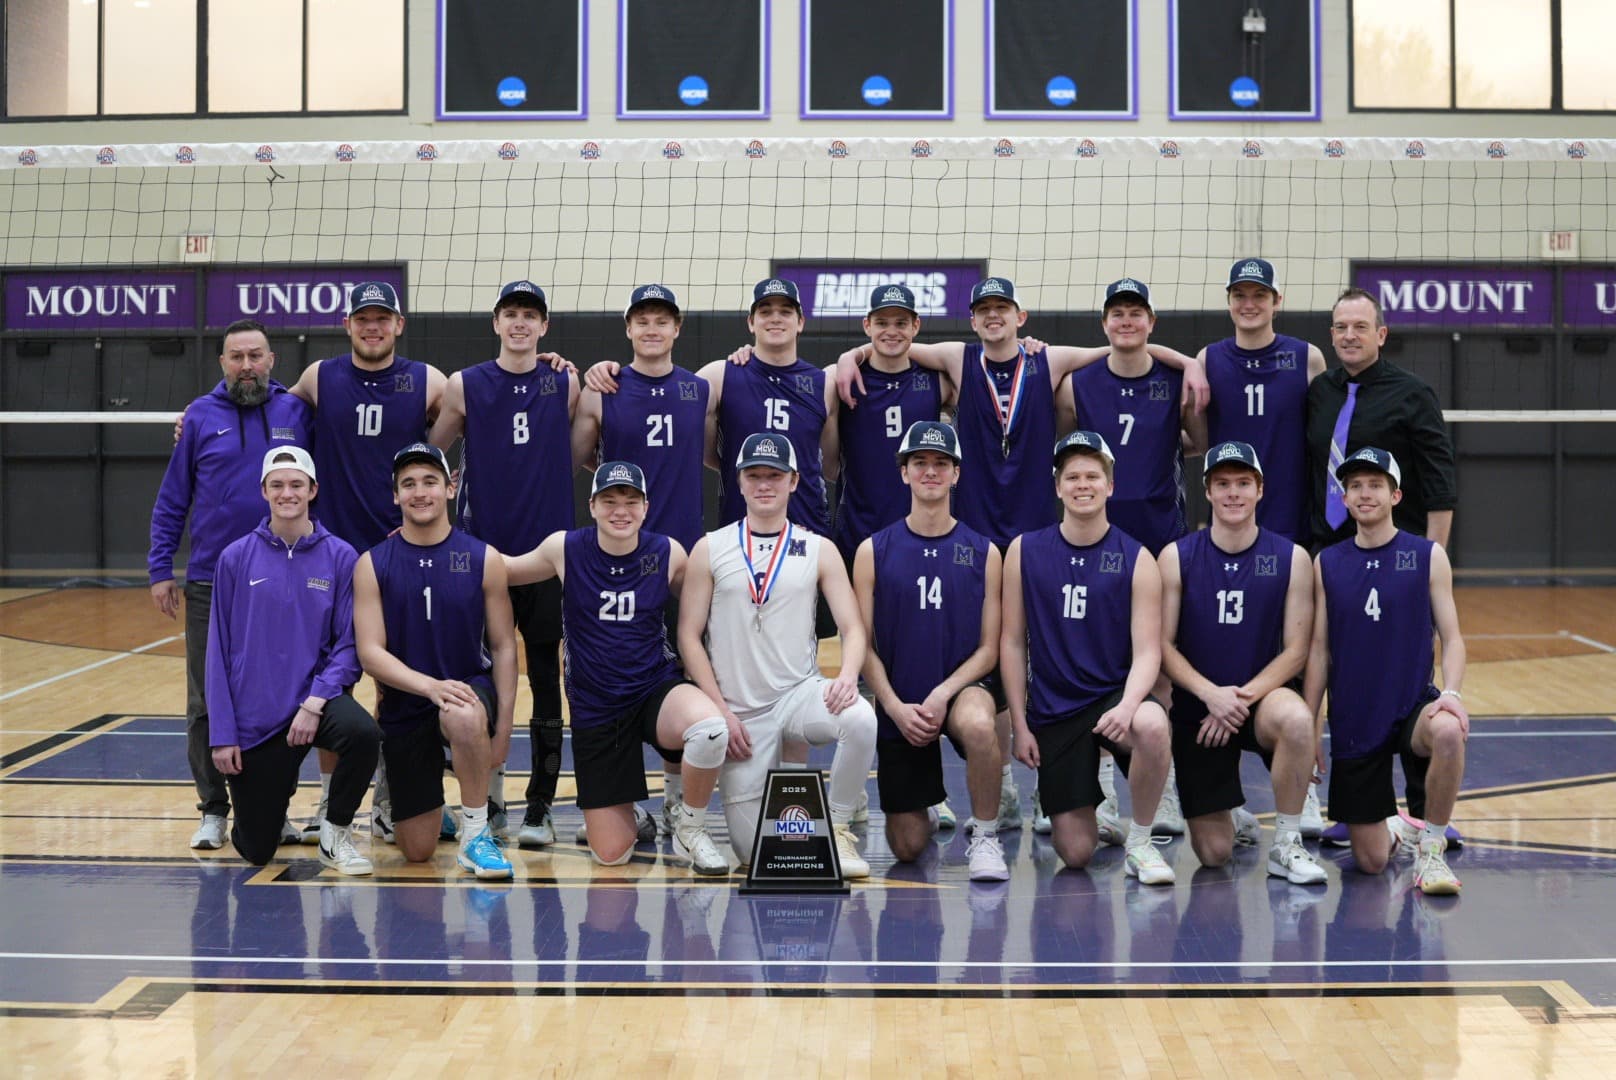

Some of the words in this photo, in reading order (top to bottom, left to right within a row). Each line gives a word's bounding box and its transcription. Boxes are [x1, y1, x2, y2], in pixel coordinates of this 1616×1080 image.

[186, 235, 208, 254] EXIT
[26, 285, 176, 316] MOUNT
[815, 273, 947, 308] RAIRS
[1378, 280, 1533, 313] MOUNT
[764, 398, 790, 430] 15
[1244, 384, 1264, 416] 11
[355, 403, 383, 436] 10
[513, 411, 530, 445] 8
[646, 414, 673, 446] 21
[885, 405, 902, 438] 9
[1118, 413, 1135, 446] 7
[787, 538, 807, 557] M
[423, 586, 432, 621] 1
[598, 590, 635, 621] 20
[916, 575, 943, 610] 14
[1062, 583, 1087, 619] 16
[1216, 589, 1244, 624] 13
[1364, 587, 1381, 621] 4
[776, 822, 814, 833] MCVL
